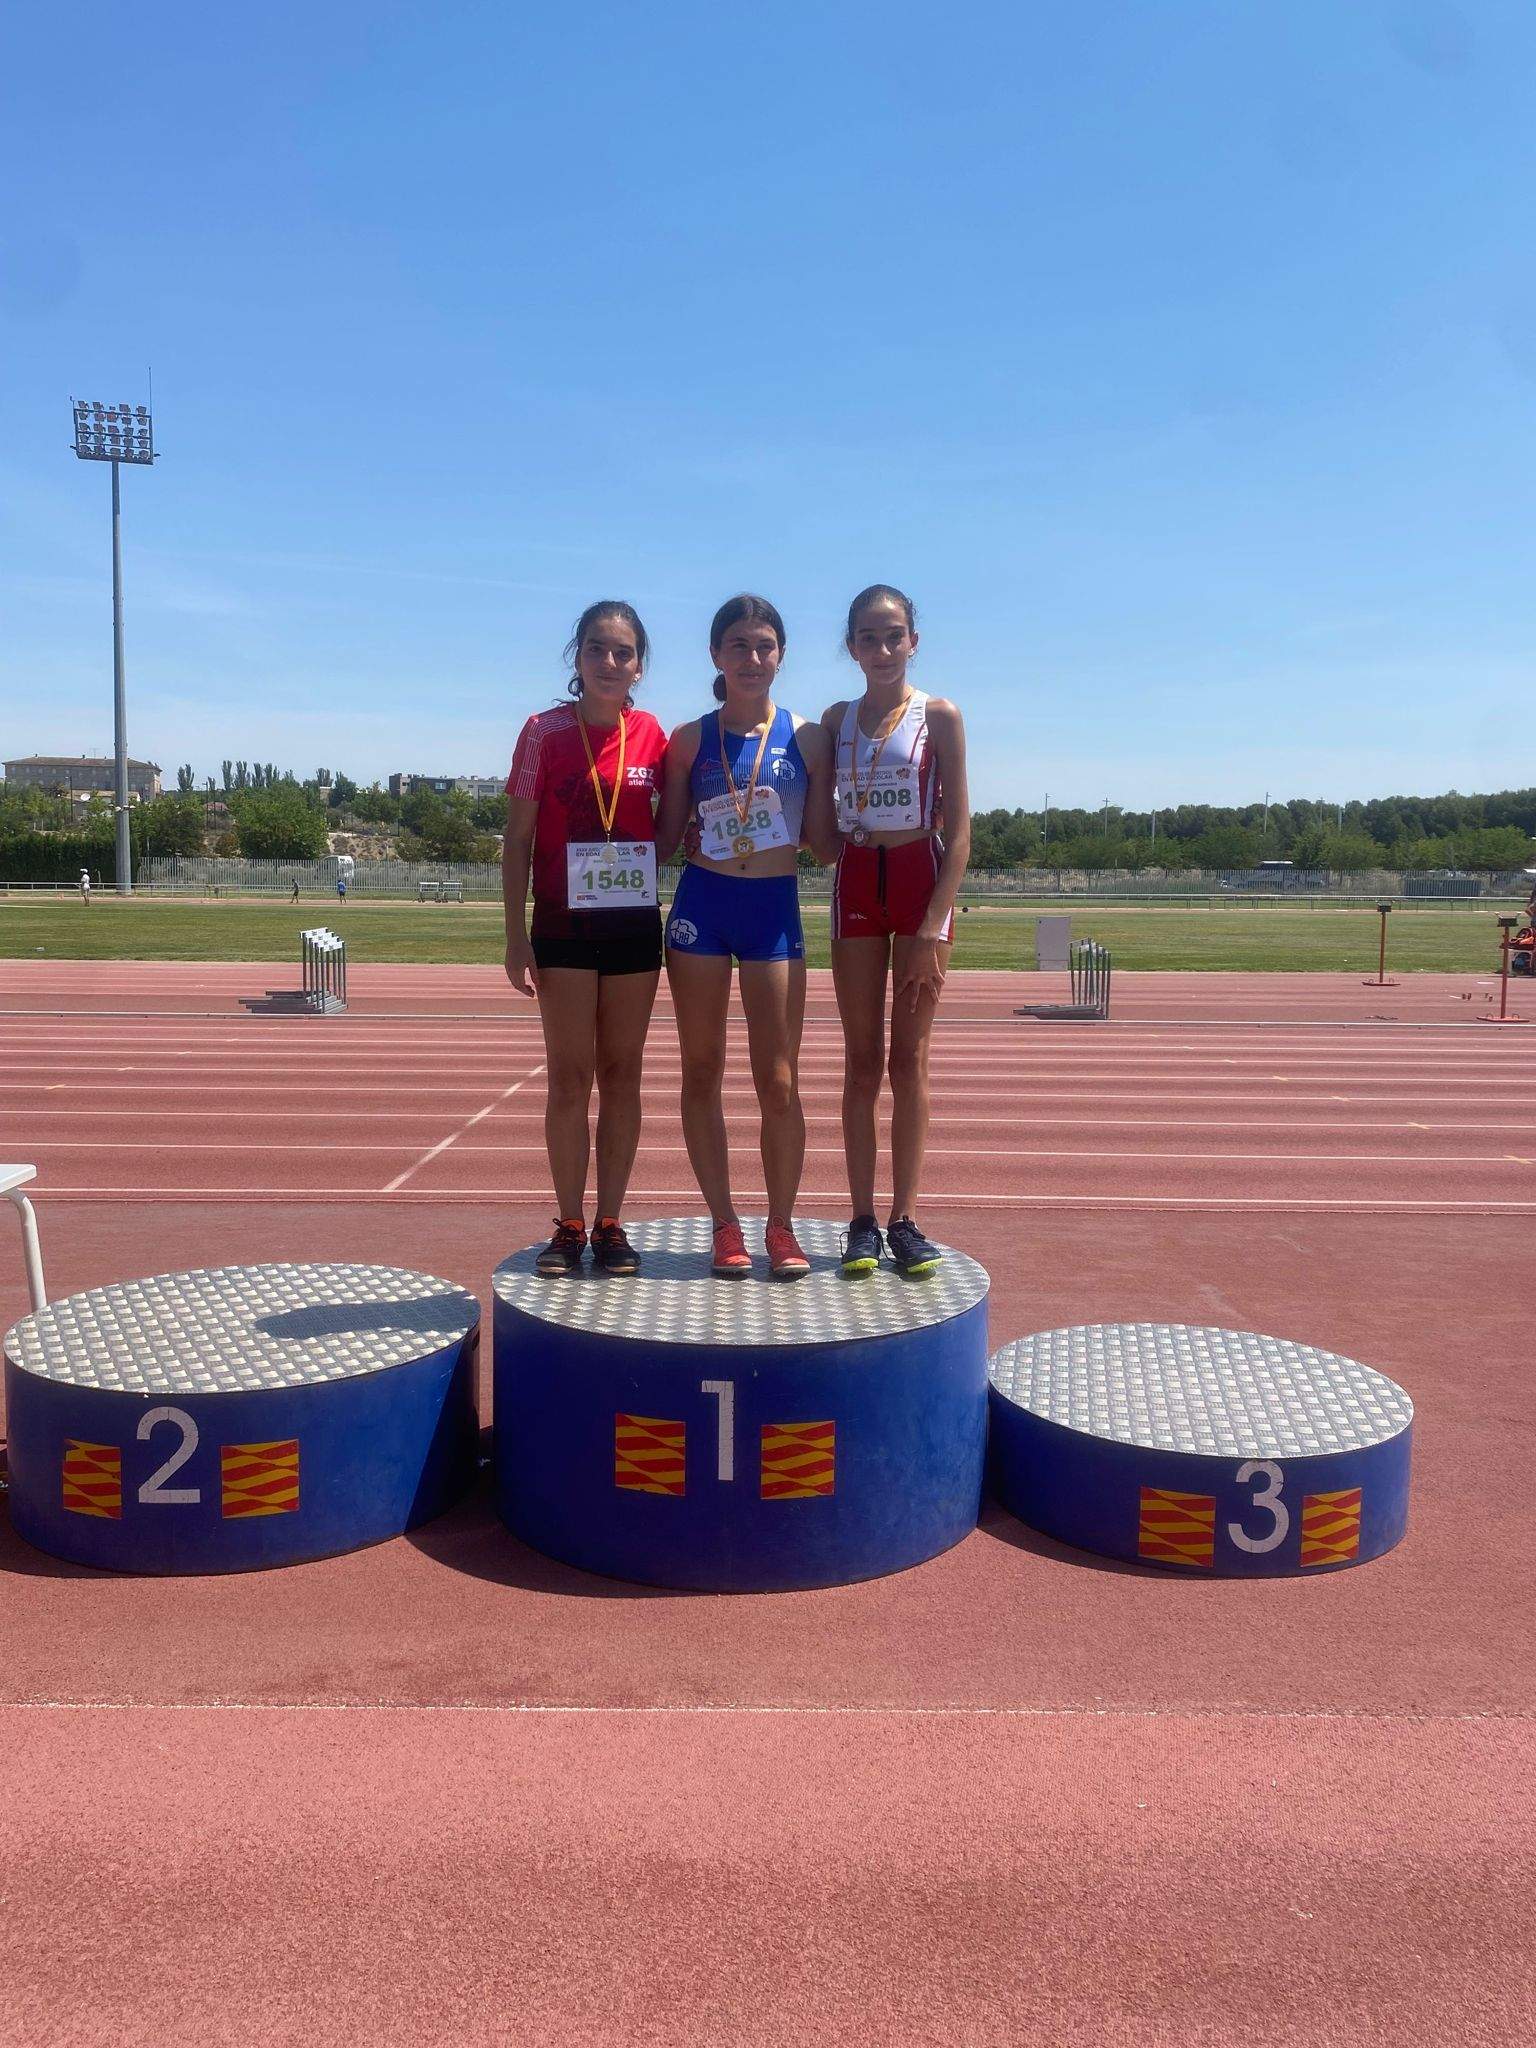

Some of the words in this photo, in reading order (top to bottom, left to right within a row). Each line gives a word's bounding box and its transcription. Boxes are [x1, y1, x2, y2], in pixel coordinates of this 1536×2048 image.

[626, 767, 654, 779] ZGZ
[711, 810, 772, 841] 1828
[582, 869, 645, 890] 1548
[136, 1406, 200, 1504] 2
[701, 1380, 735, 1481] 1
[1227, 1458, 1290, 1554] 3
